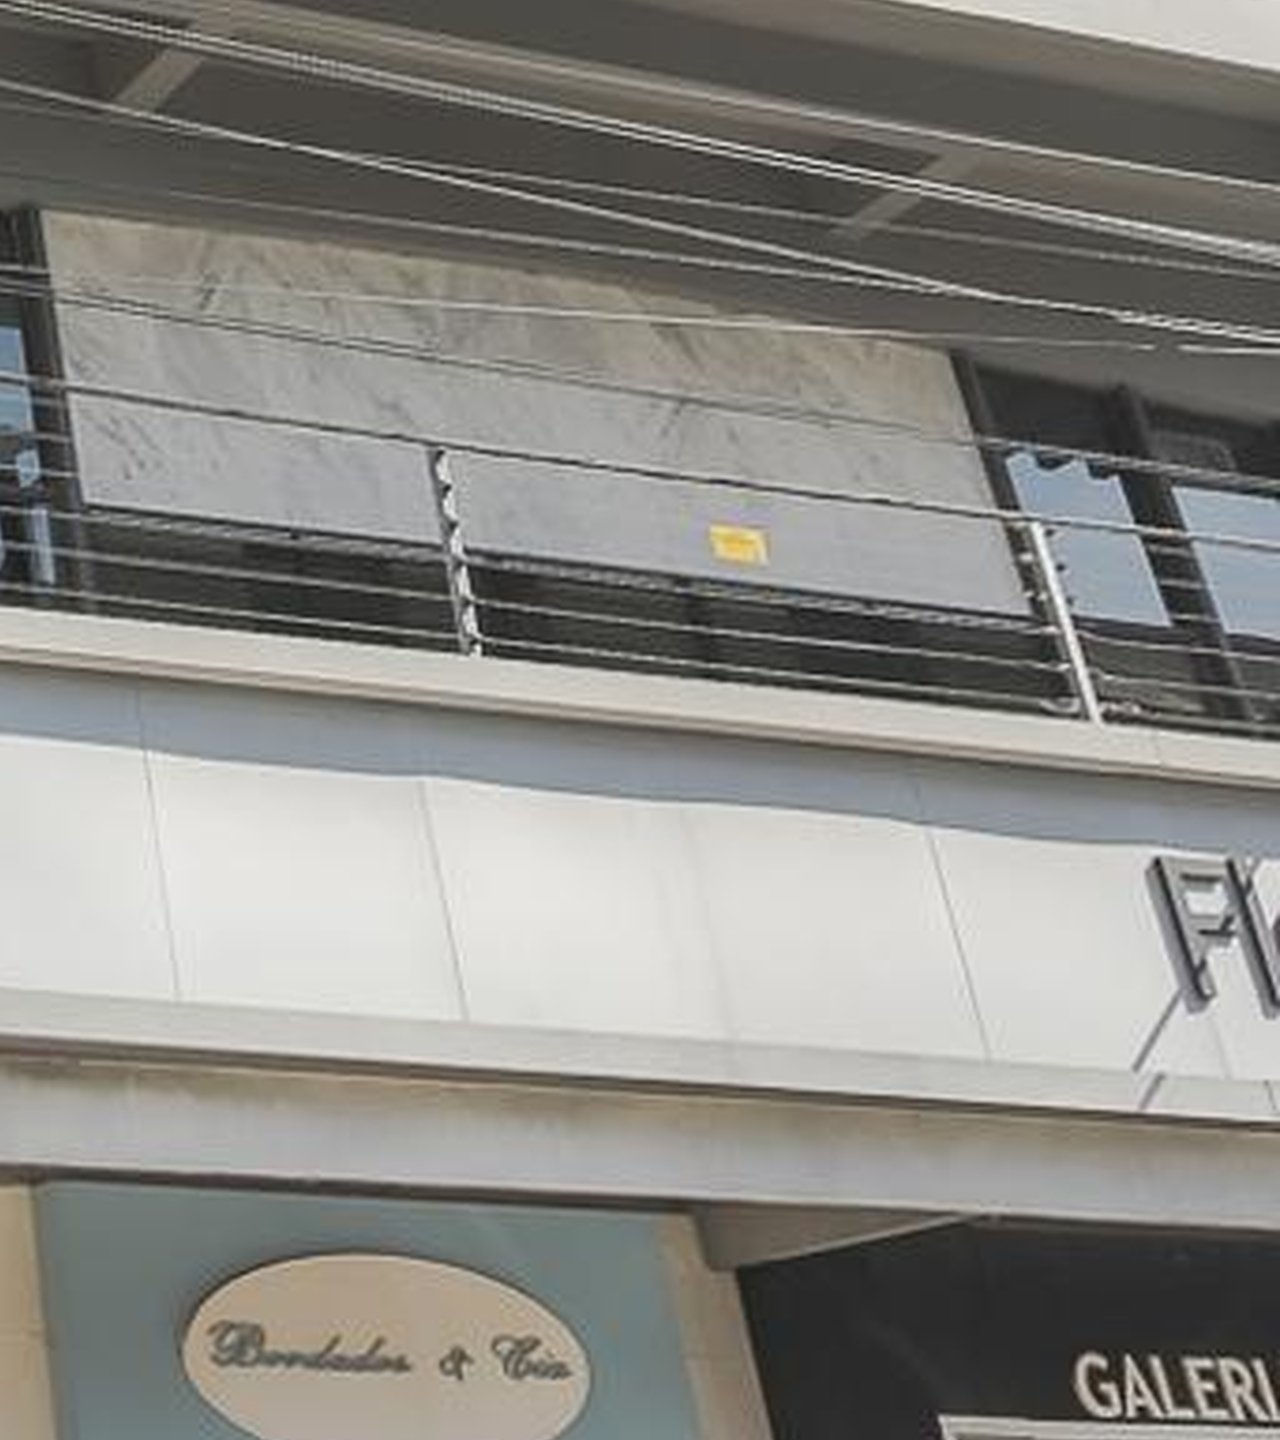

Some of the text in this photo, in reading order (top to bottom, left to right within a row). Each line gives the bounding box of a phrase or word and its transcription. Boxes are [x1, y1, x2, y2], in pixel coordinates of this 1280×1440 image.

[207, 1320, 572, 1381] Bordados & Cia
[1074, 1351, 1280, 1421] GALERI
